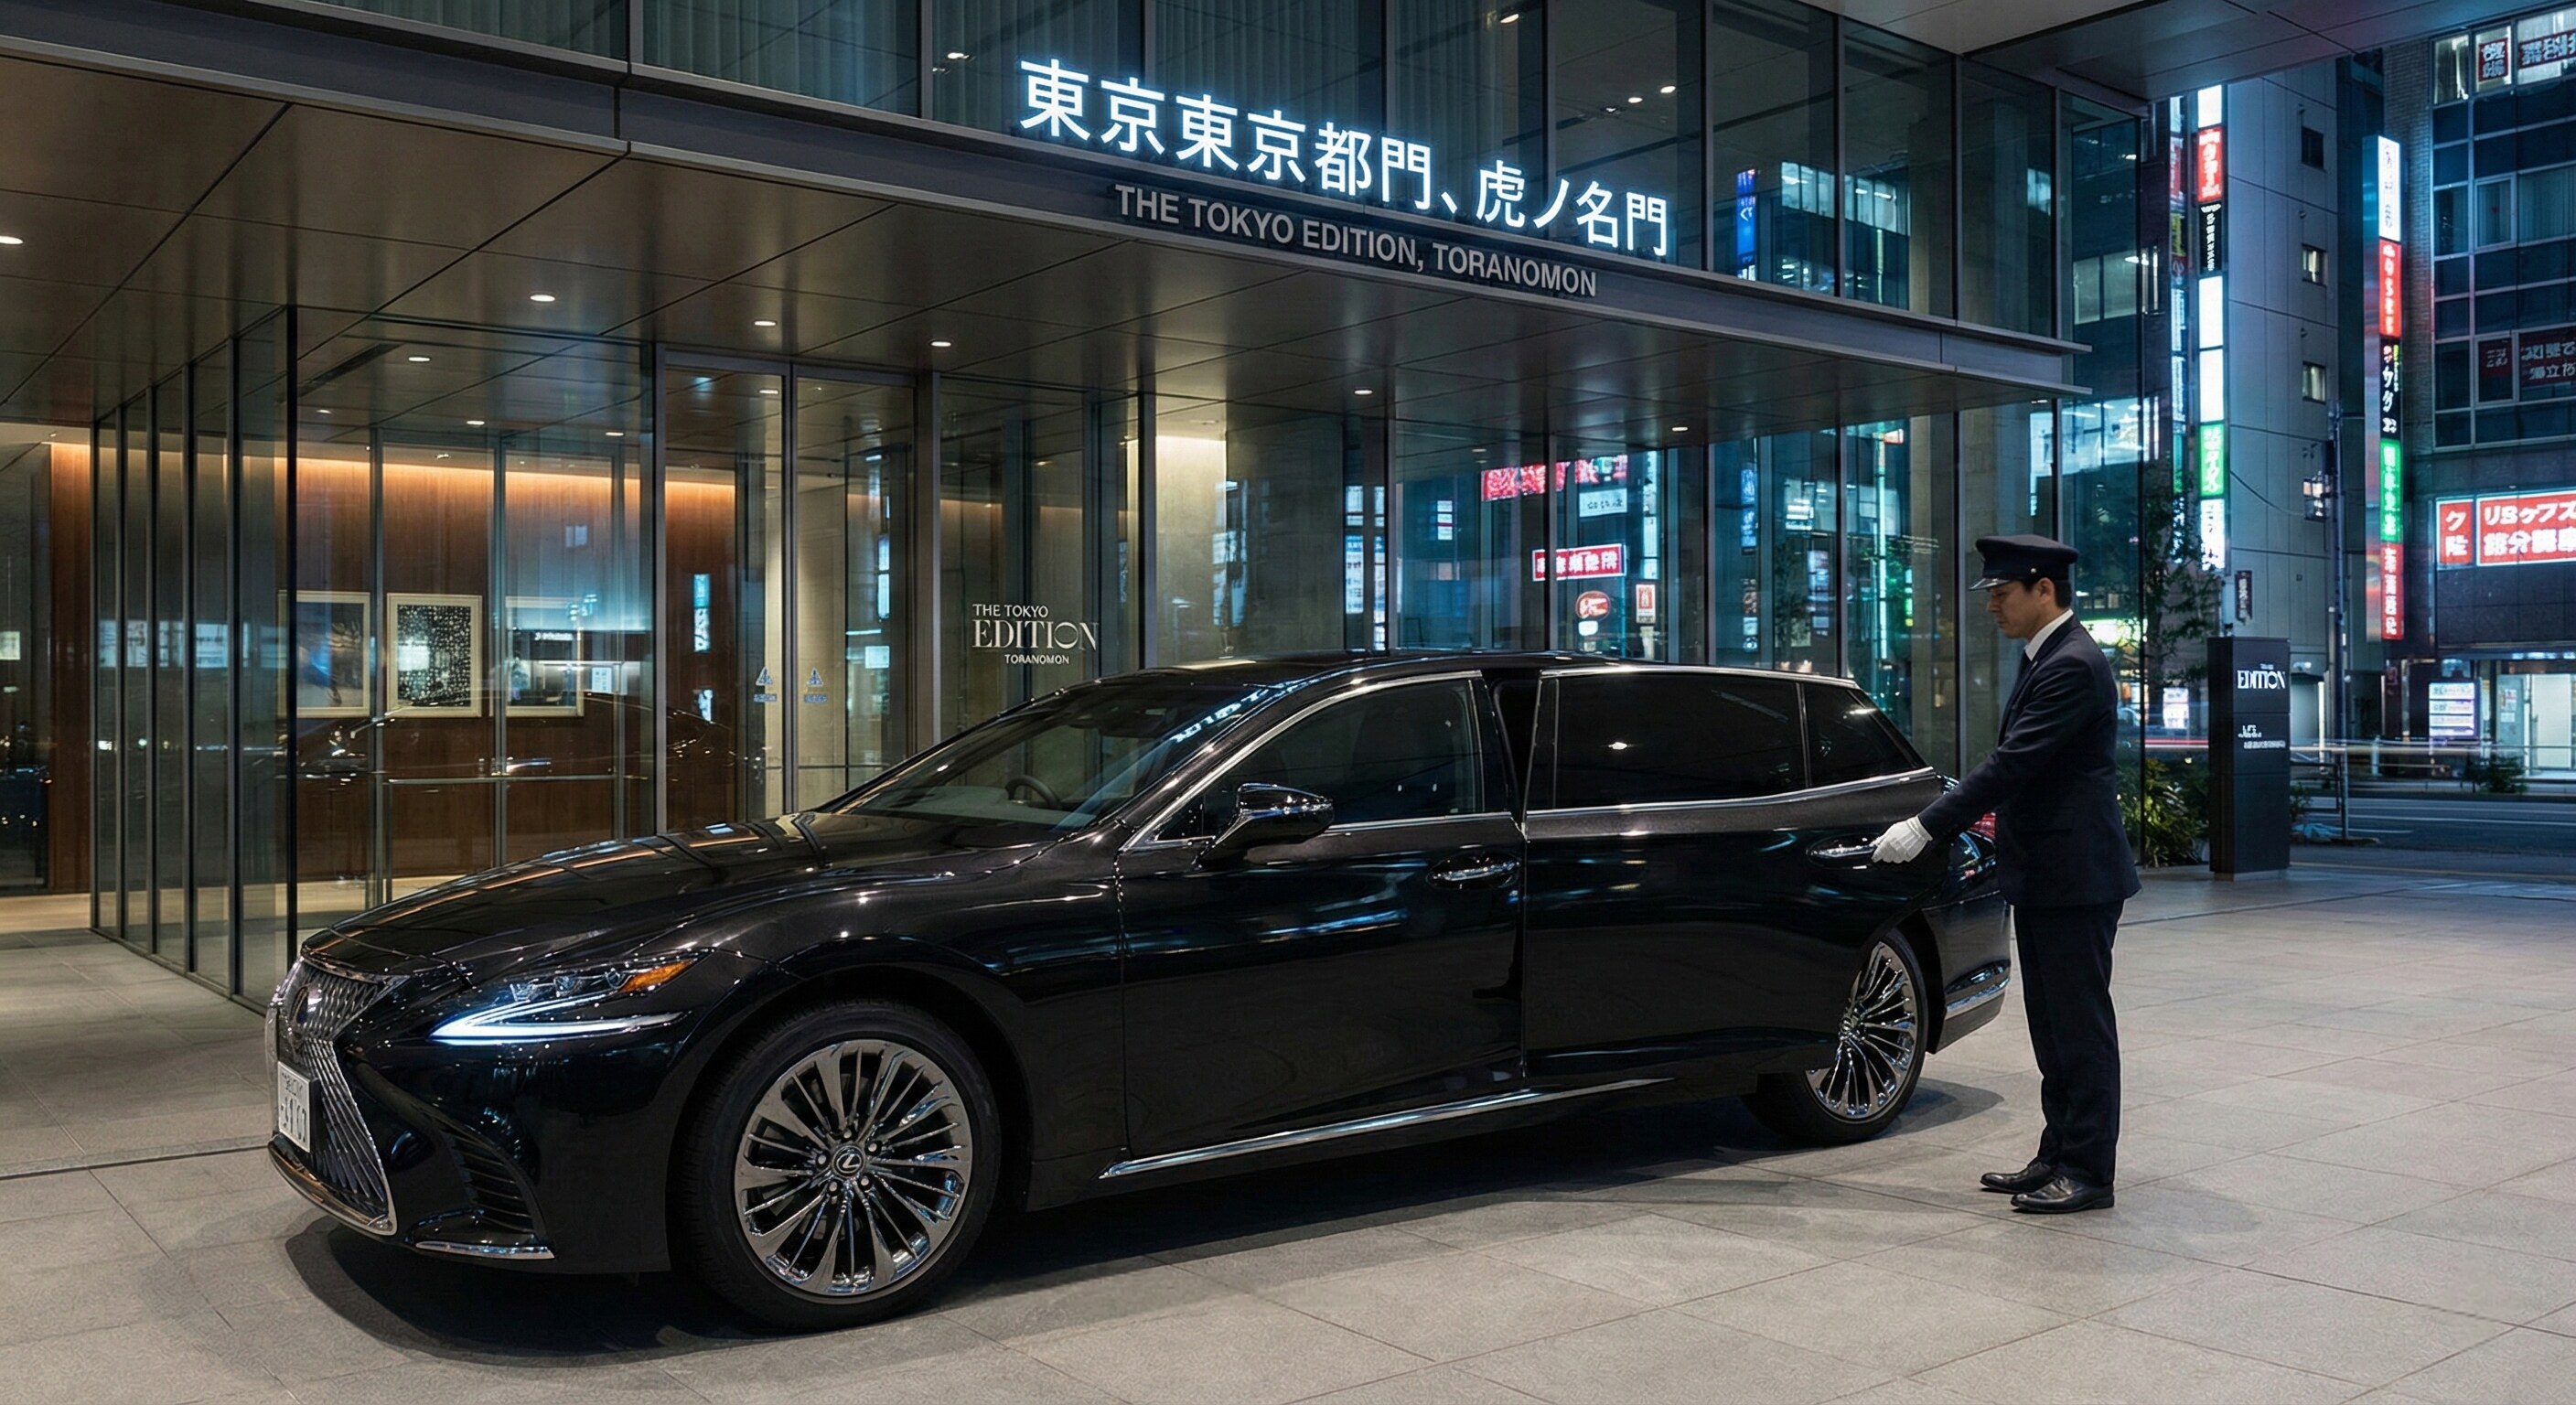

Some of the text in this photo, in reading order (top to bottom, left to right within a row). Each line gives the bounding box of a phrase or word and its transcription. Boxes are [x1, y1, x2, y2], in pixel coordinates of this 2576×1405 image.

[1019, 58, 1669, 257] 東京東京都門、虎ノ名門
[1115, 184, 1598, 298] THE TOKYO EDITION, TORANOMON
[972, 604, 1049, 617] THE TOKYO
[971, 619, 1099, 650] EDITION
[1004, 654, 1069, 665] TORANOMON
